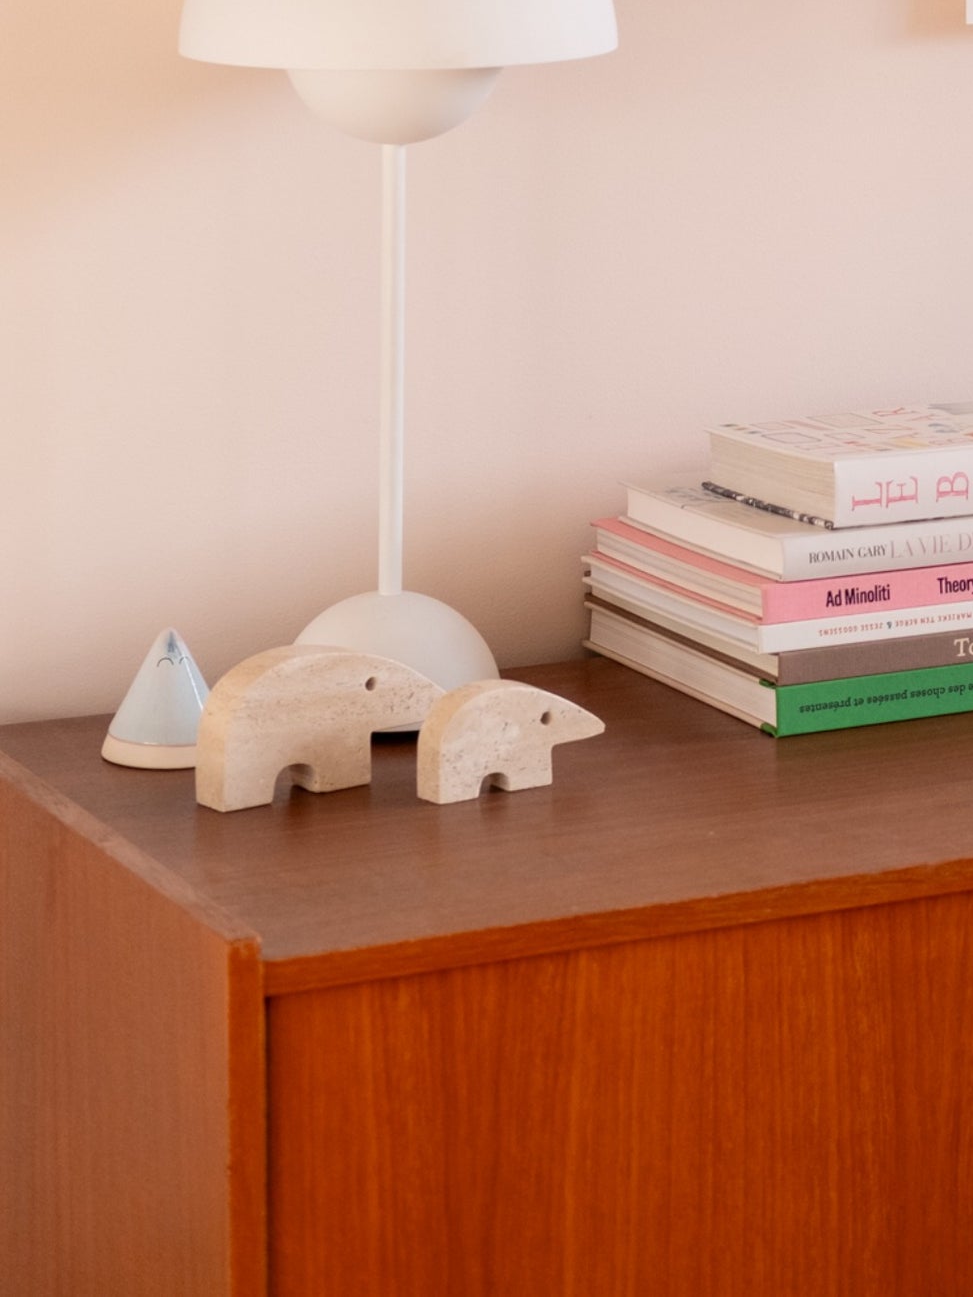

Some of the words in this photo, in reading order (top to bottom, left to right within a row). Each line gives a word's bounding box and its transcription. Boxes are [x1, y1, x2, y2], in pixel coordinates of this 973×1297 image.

[890, 540, 913, 559] LA
[918, 533, 952, 555] VIE
[809, 549, 855, 564] ROMAIN
[858, 545, 887, 559] GARY
[826, 589, 842, 608] Ad
[845, 584, 891, 605] Minoliti
[919, 615, 936, 624] TEN
[938, 612, 973, 622] MARIEKE
[861, 622, 884, 632] JESSE
[910, 687, 946, 700] choses
[948, 685, 966, 695] des
[853, 697, 864, 707] et
[867, 690, 908, 705] passées
[799, 697, 852, 713] présentes
